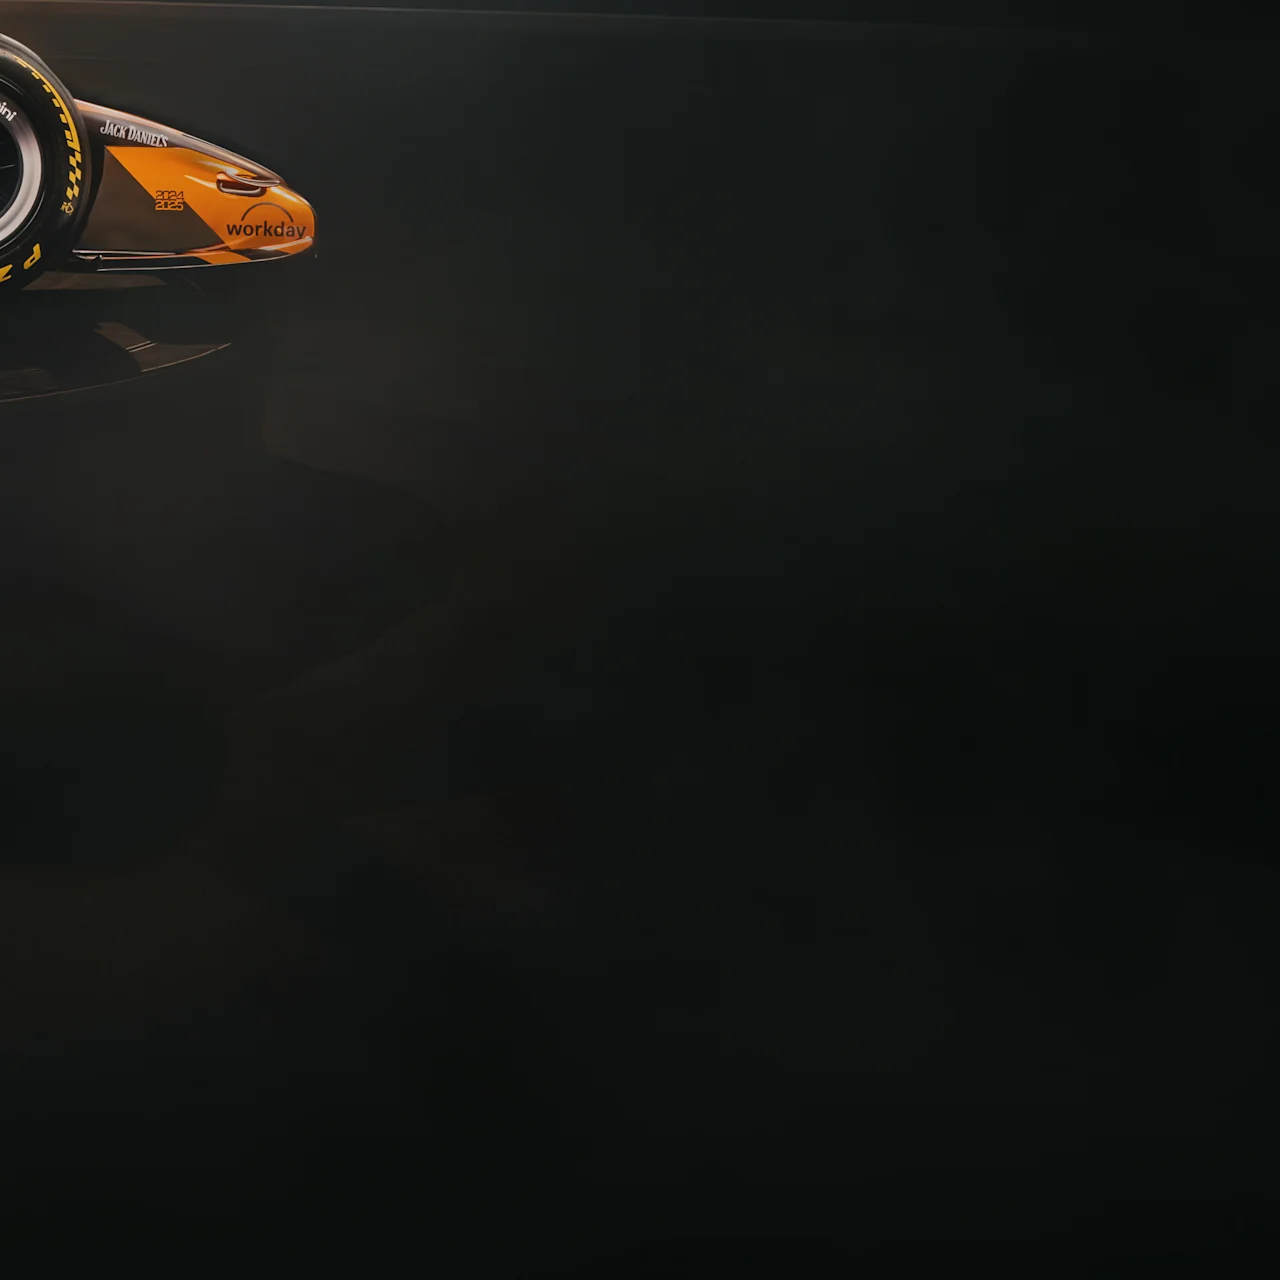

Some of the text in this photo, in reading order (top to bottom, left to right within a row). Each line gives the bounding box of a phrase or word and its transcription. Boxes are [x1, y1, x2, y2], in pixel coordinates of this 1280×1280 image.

[100, 120, 128, 139] JACK
[226, 221, 307, 240] workday
[23, 243, 42, 270] P
